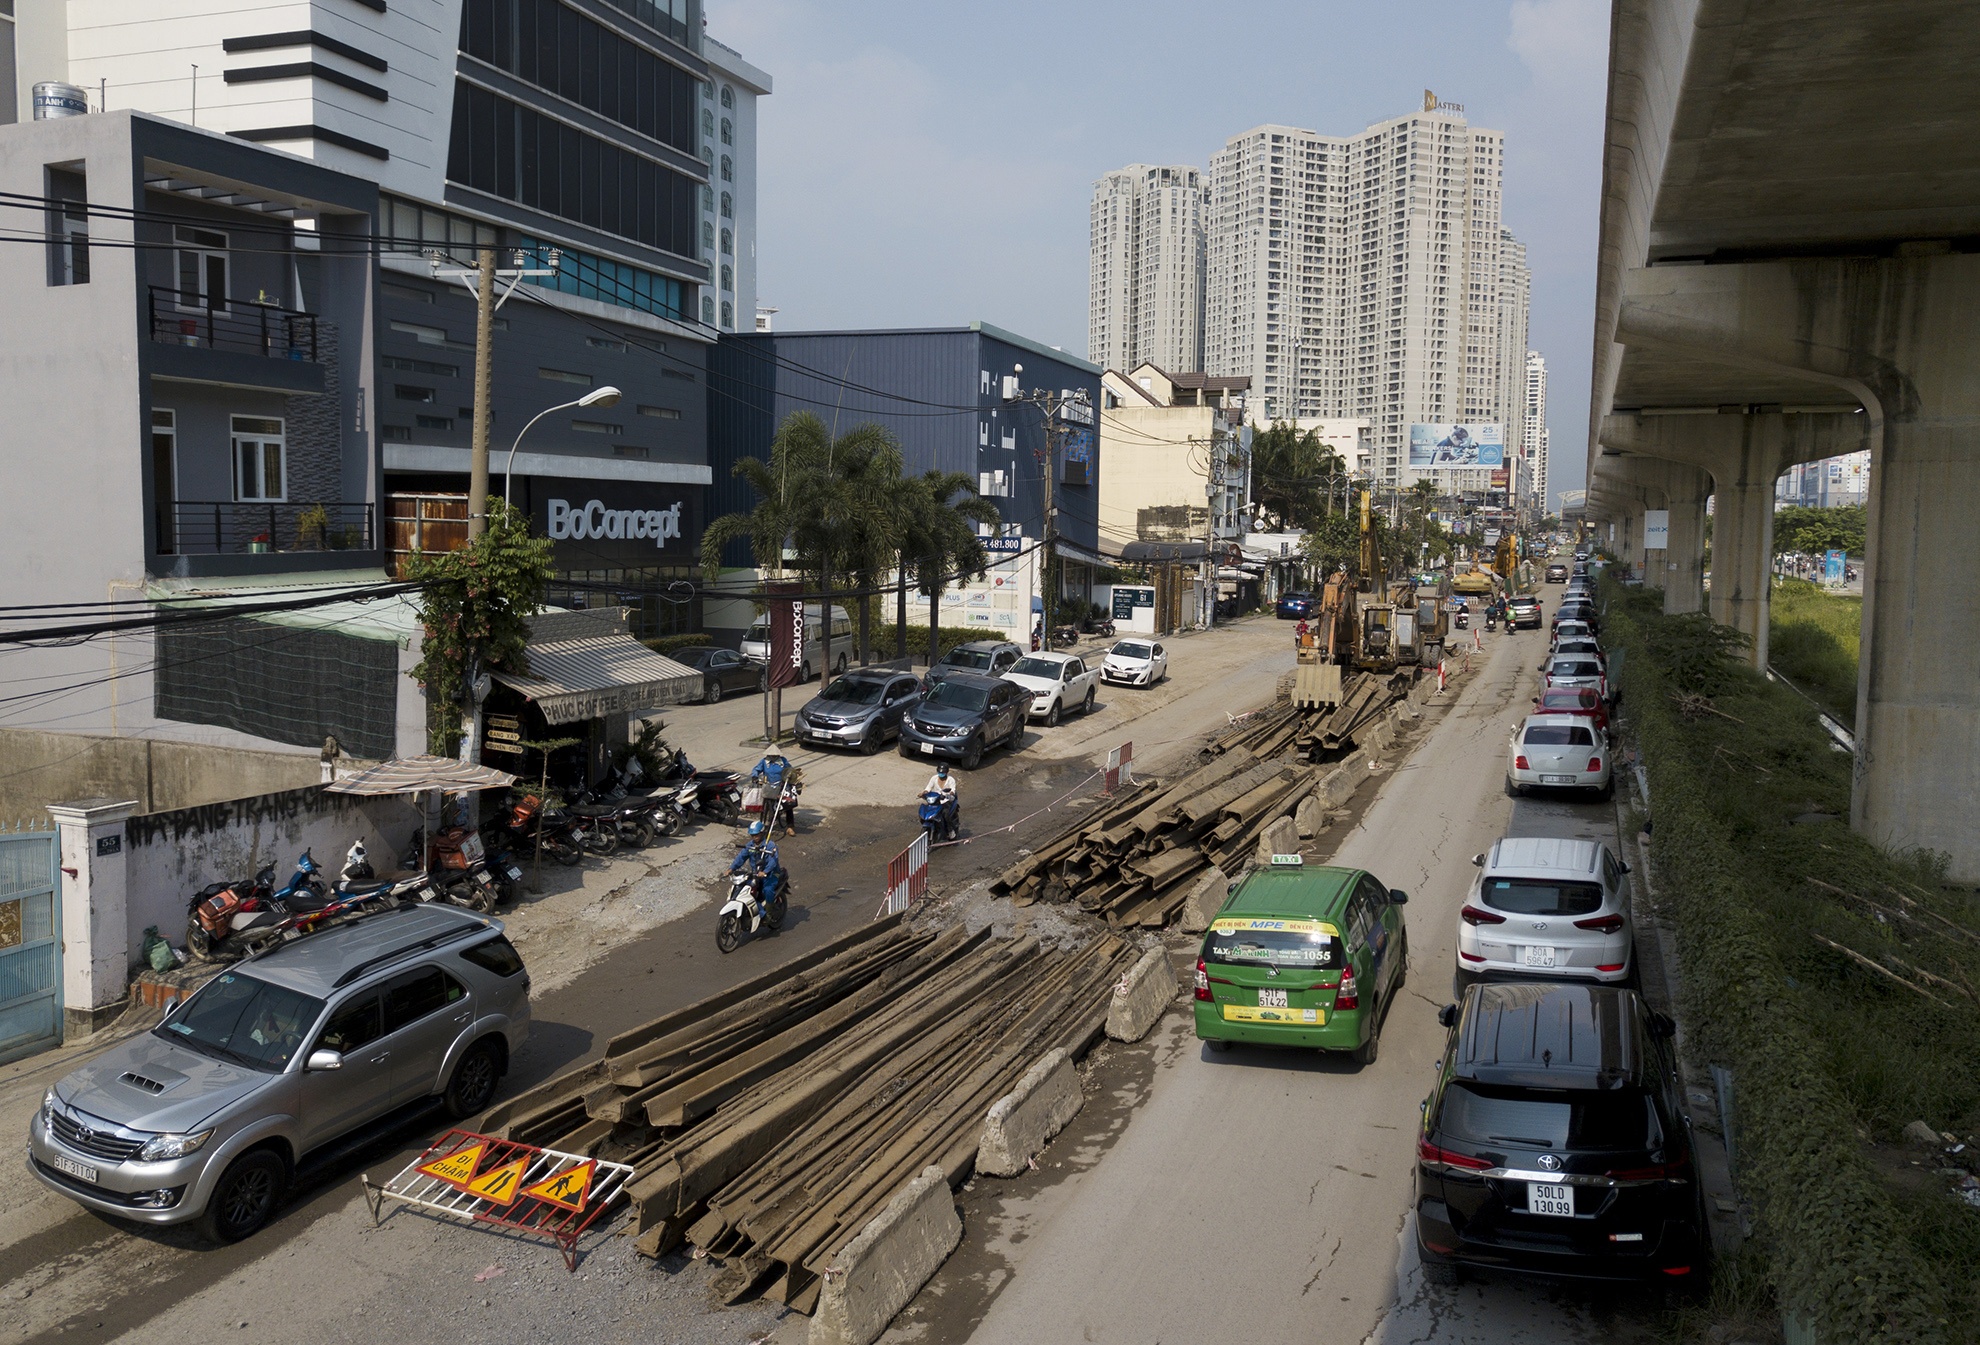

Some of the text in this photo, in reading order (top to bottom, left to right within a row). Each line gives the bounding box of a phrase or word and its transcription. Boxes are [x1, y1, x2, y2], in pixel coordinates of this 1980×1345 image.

[547, 499, 681, 549] BoConcept
[791, 601, 803, 669] BoConcept
[543, 699, 575, 720] PHÚC
[578, 695, 618, 715] COFFEE
[101, 836, 116, 847] 55
[1250, 920, 1284, 929] MPE
[1304, 950, 1331, 960] 1055
[1532, 947, 1548, 957] 60A
[1265, 988, 1280, 997] 51F
[456, 1154, 473, 1165] ĐI
[54, 1155, 96, 1182] 51F-311.04
[432, 1161, 469, 1180] CHẬM
[1537, 1185, 1565, 1200] 50LD
[1534, 1200, 1571, 1215] 130.99
